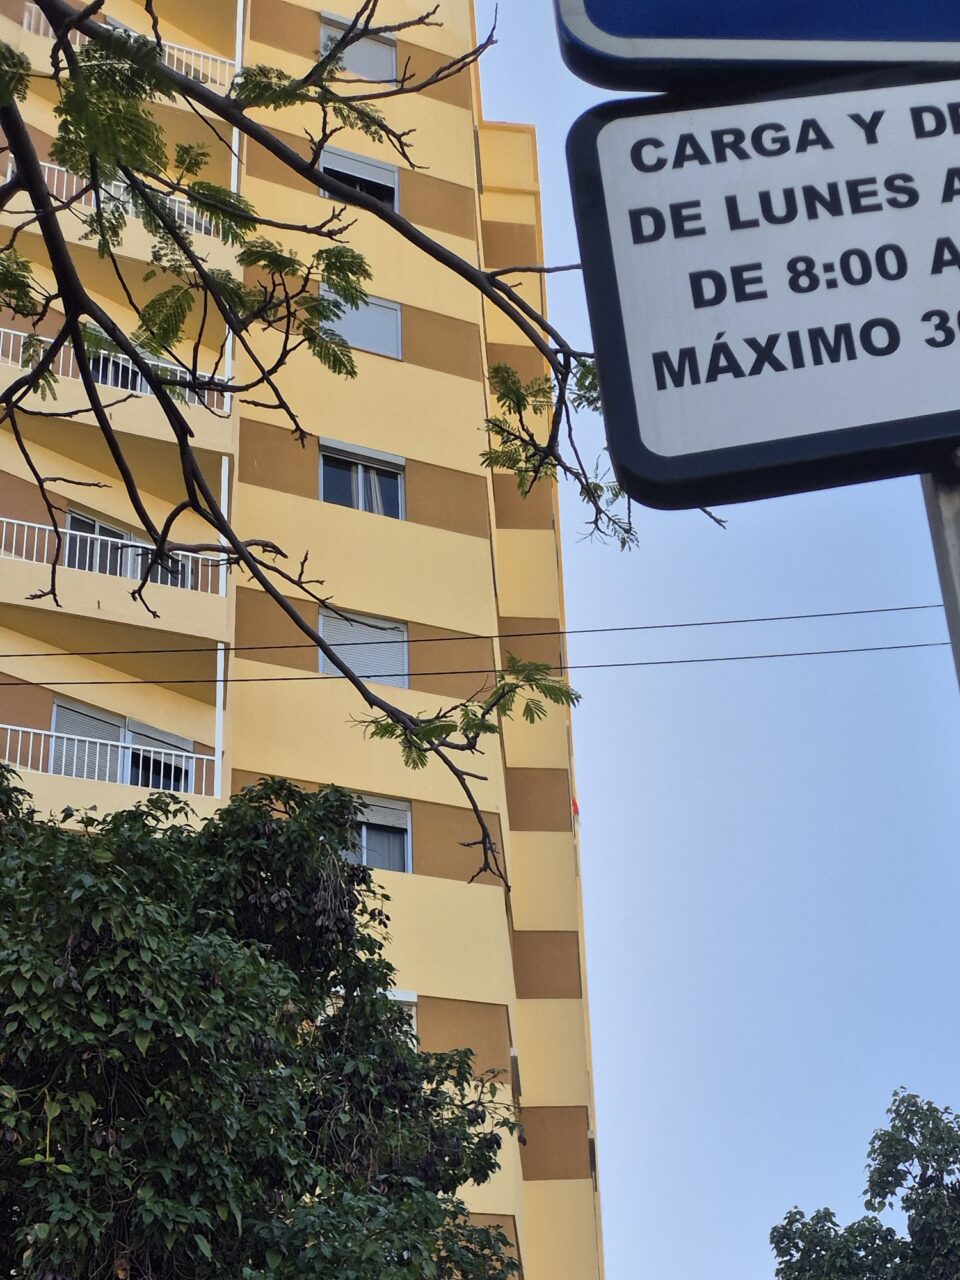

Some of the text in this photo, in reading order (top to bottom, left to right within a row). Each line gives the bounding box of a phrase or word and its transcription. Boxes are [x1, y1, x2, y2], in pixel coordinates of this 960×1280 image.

[630, 118, 834, 174] CARGA
[848, 109, 886, 145] Y
[628, 199, 706, 246] DE
[725, 173, 919, 232] LUNES
[689, 262, 768, 310] DE
[787, 244, 907, 294] 8:00
[652, 317, 901, 392] MÁXIMO
